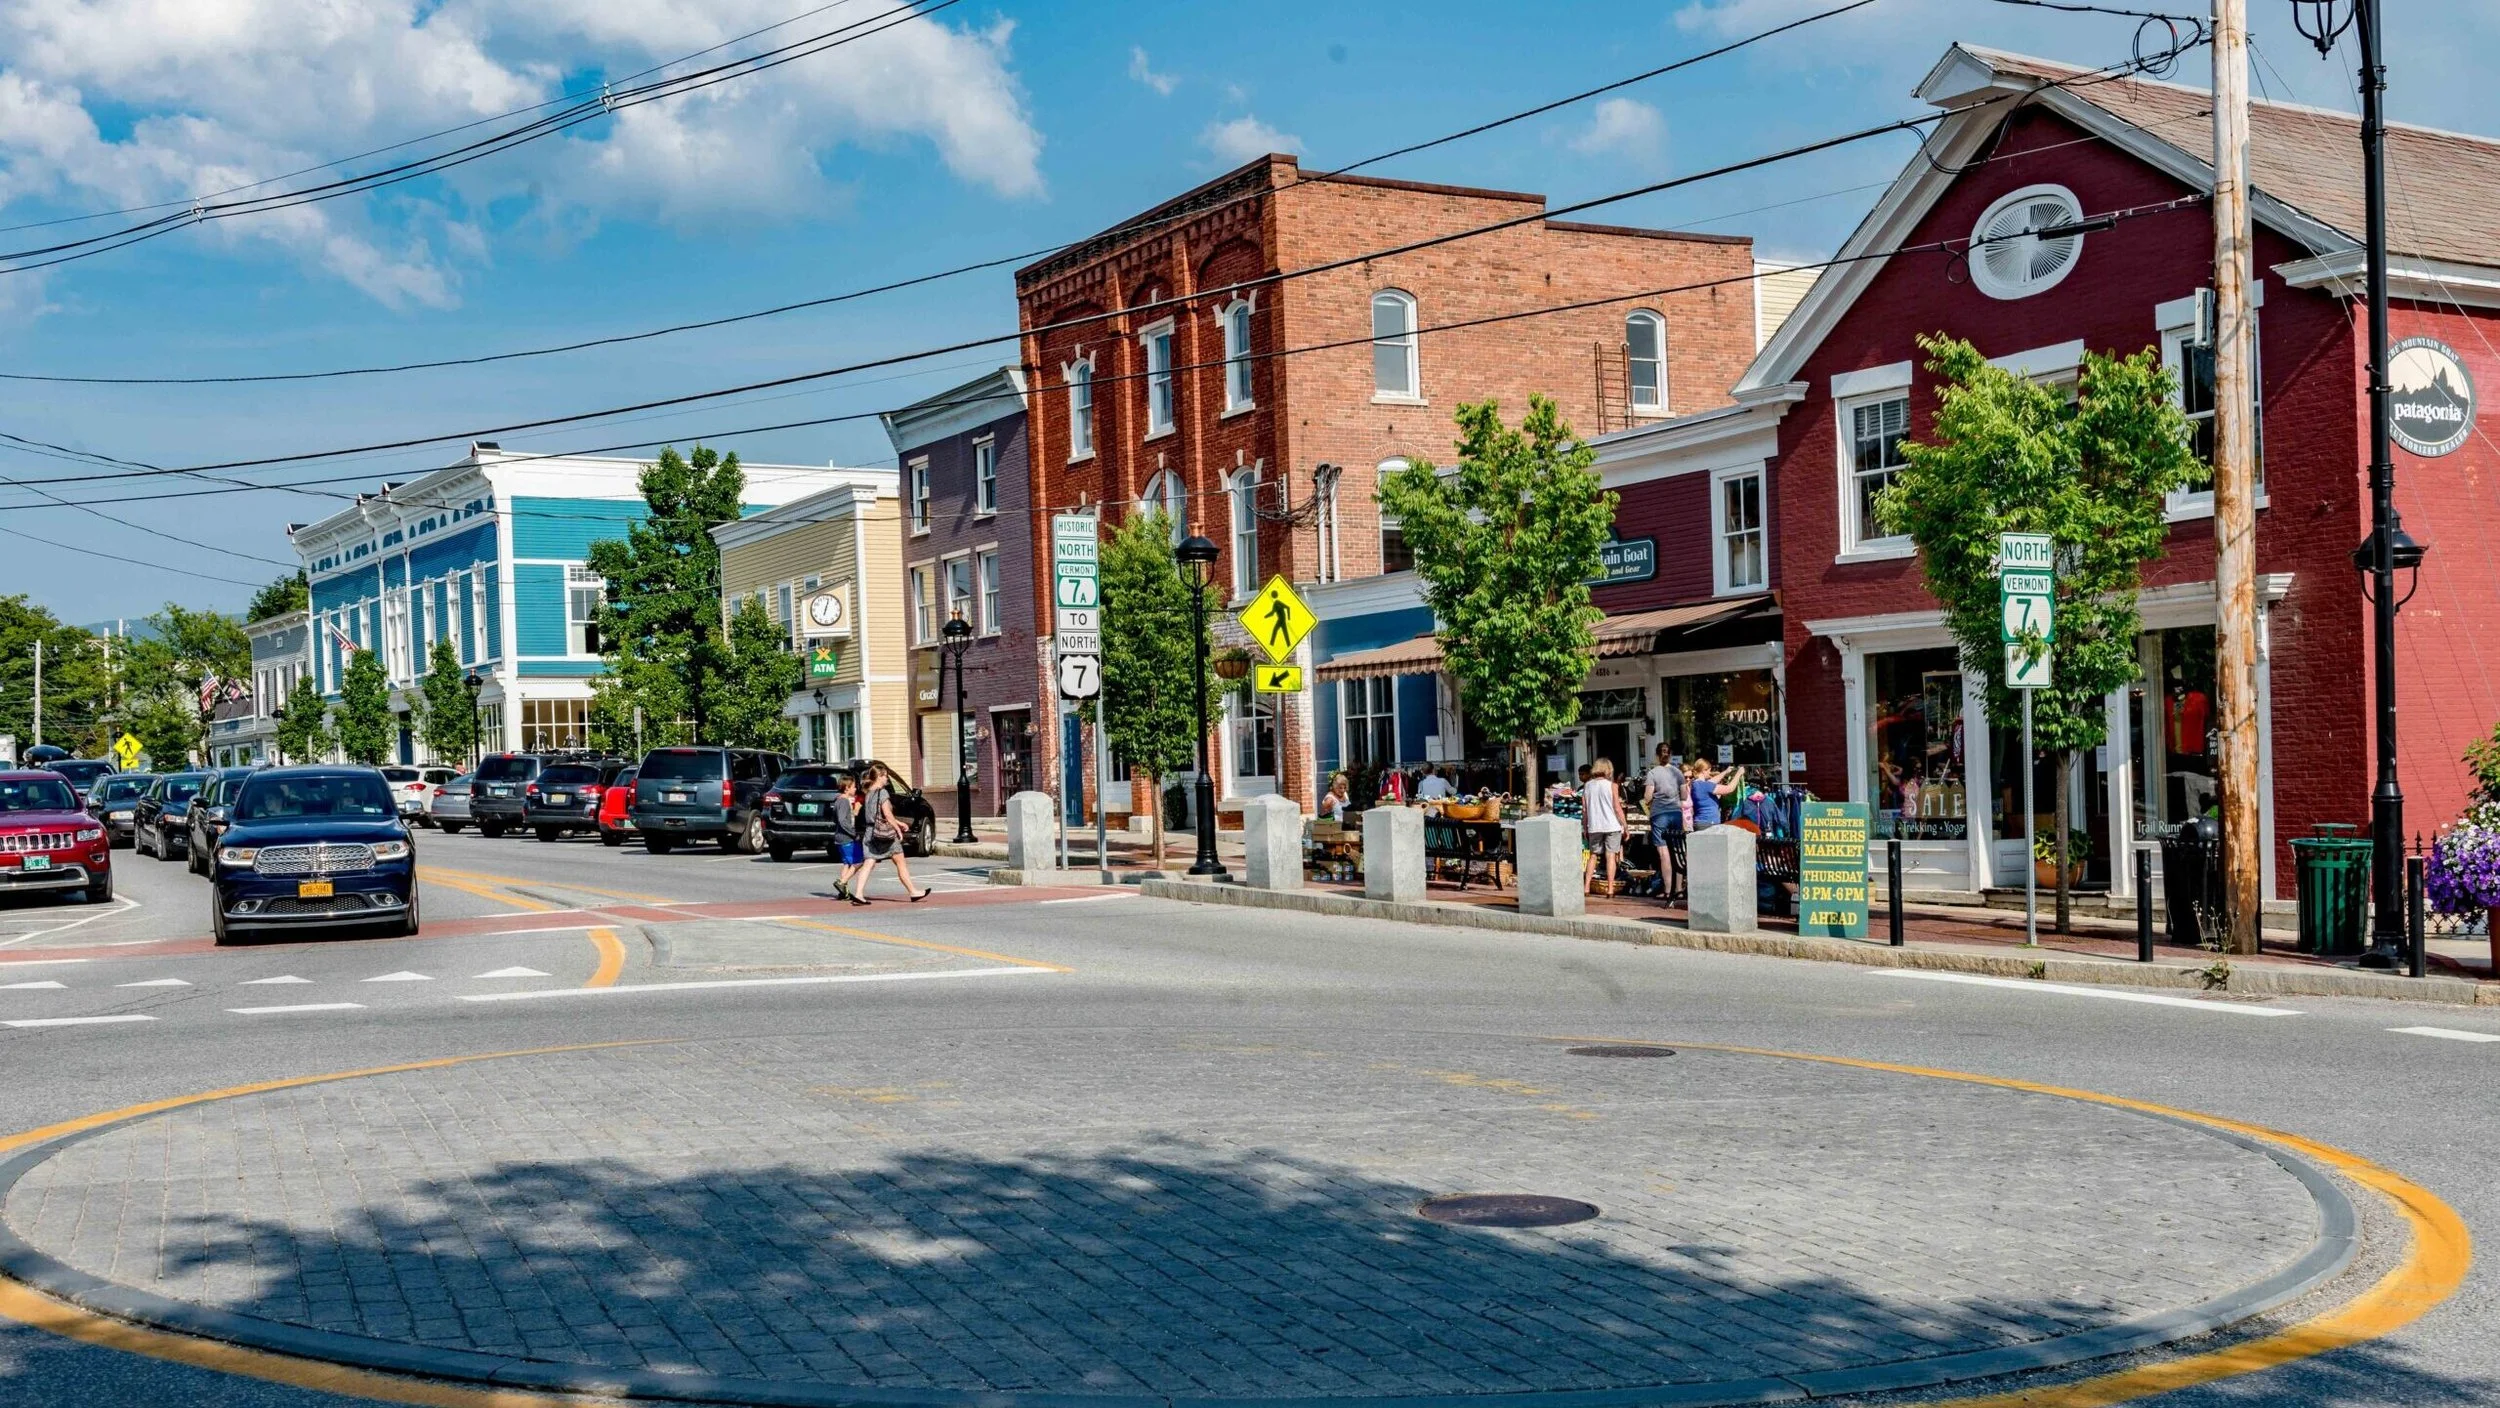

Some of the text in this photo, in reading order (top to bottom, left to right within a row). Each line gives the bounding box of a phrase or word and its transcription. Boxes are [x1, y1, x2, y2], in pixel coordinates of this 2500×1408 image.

[2401, 337, 2440, 350] MOUNTAIN
[2440, 343, 2460, 362] GOAT
[2394, 401, 2462, 423] patagonia
[2440, 429, 2469, 453] DEALER
[1058, 521, 1093, 533] HISTORIC
[1058, 543, 1094, 556] NORTH
[1623, 547, 1648, 563] Goat
[2005, 542, 2049, 561] NORTH
[1060, 565, 1094, 575] VERMONT
[1611, 567, 1623, 576] and
[1624, 564, 1641, 574] Gear
[2006, 577, 2049, 591] VERMONT
[1068, 579, 1087, 604] 7A
[1069, 612, 1088, 626] TO
[1061, 635, 1097, 649] NORTH
[813, 663, 836, 673] ATM
[1072, 664, 1087, 690] 7
[1908, 793, 1965, 817] SALE
[1826, 808, 1844, 817] THE
[1804, 818, 1865, 828] MANCHESTER
[1874, 821, 1896, 834] Travel
[1901, 821, 1938, 836] Trekking
[2136, 820, 2156, 834] Trail
[1803, 829, 1866, 843] FARMERS
[1803, 844, 1865, 857] MARKET
[1802, 870, 1864, 883] THURSDAY
[1808, 911, 1858, 926] AHEAD
